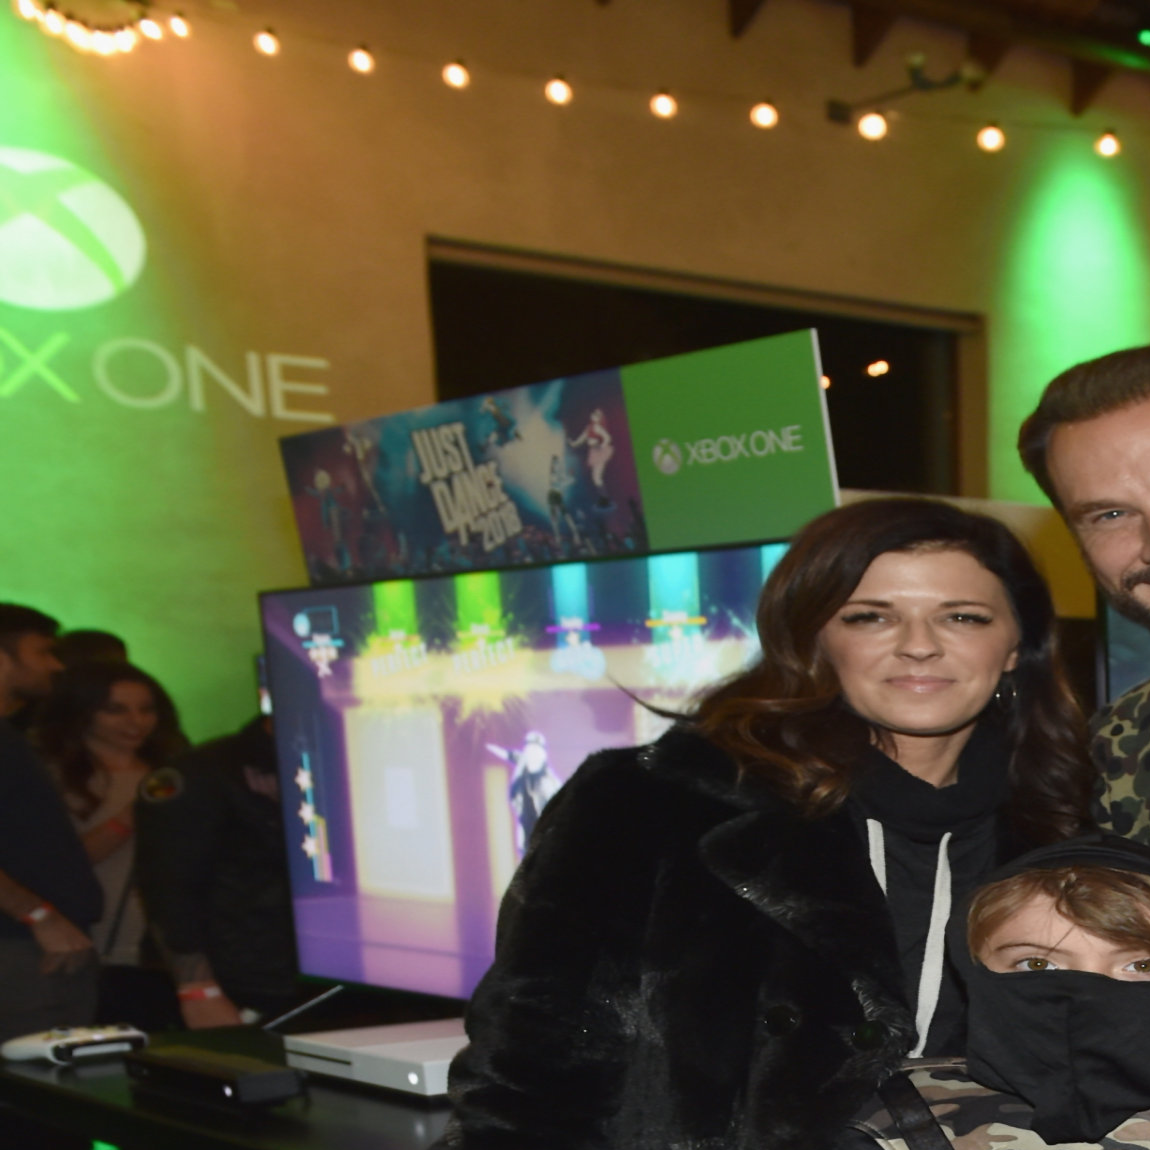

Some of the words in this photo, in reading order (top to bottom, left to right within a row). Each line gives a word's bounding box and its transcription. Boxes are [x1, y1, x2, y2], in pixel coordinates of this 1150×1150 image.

[0, 327, 80, 403] X
[91, 336, 336, 423] ONE
[412, 422, 474, 501] JUST
[684, 433, 750, 466] XBOX
[750, 424, 804, 456] ONE
[431, 462, 508, 545] DANCE
